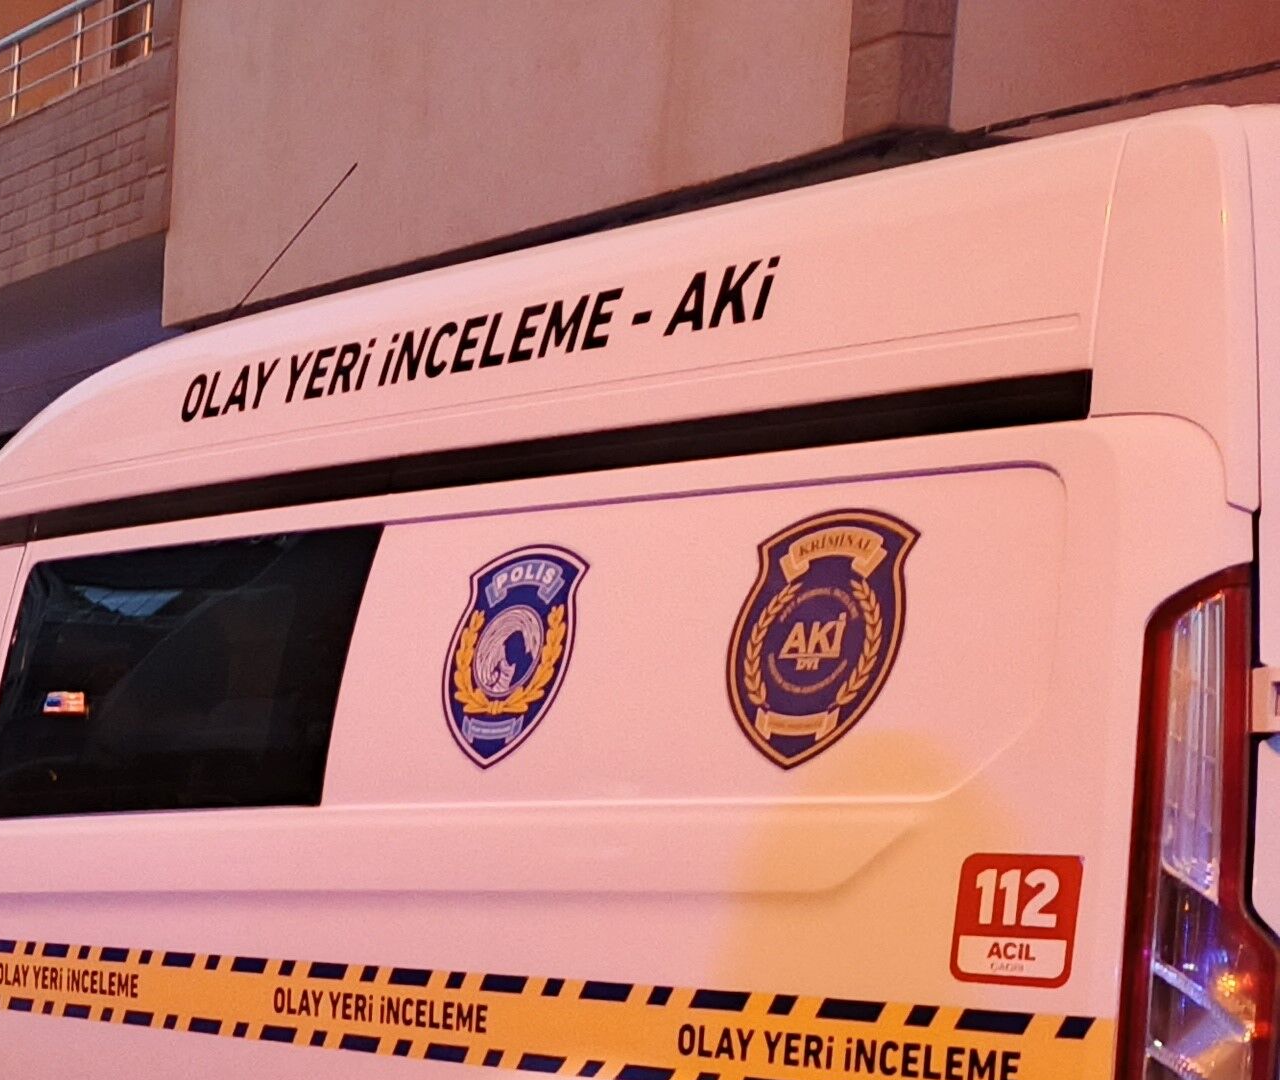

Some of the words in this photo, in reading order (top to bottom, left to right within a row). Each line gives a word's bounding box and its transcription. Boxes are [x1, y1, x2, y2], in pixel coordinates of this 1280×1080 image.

[181, 357, 281, 423] OLAY
[496, 562, 556, 590] POLİS
[975, 868, 1059, 928] 112
[273, 986, 324, 1017] OLAY
[677, 1023, 755, 1062] OLAY
